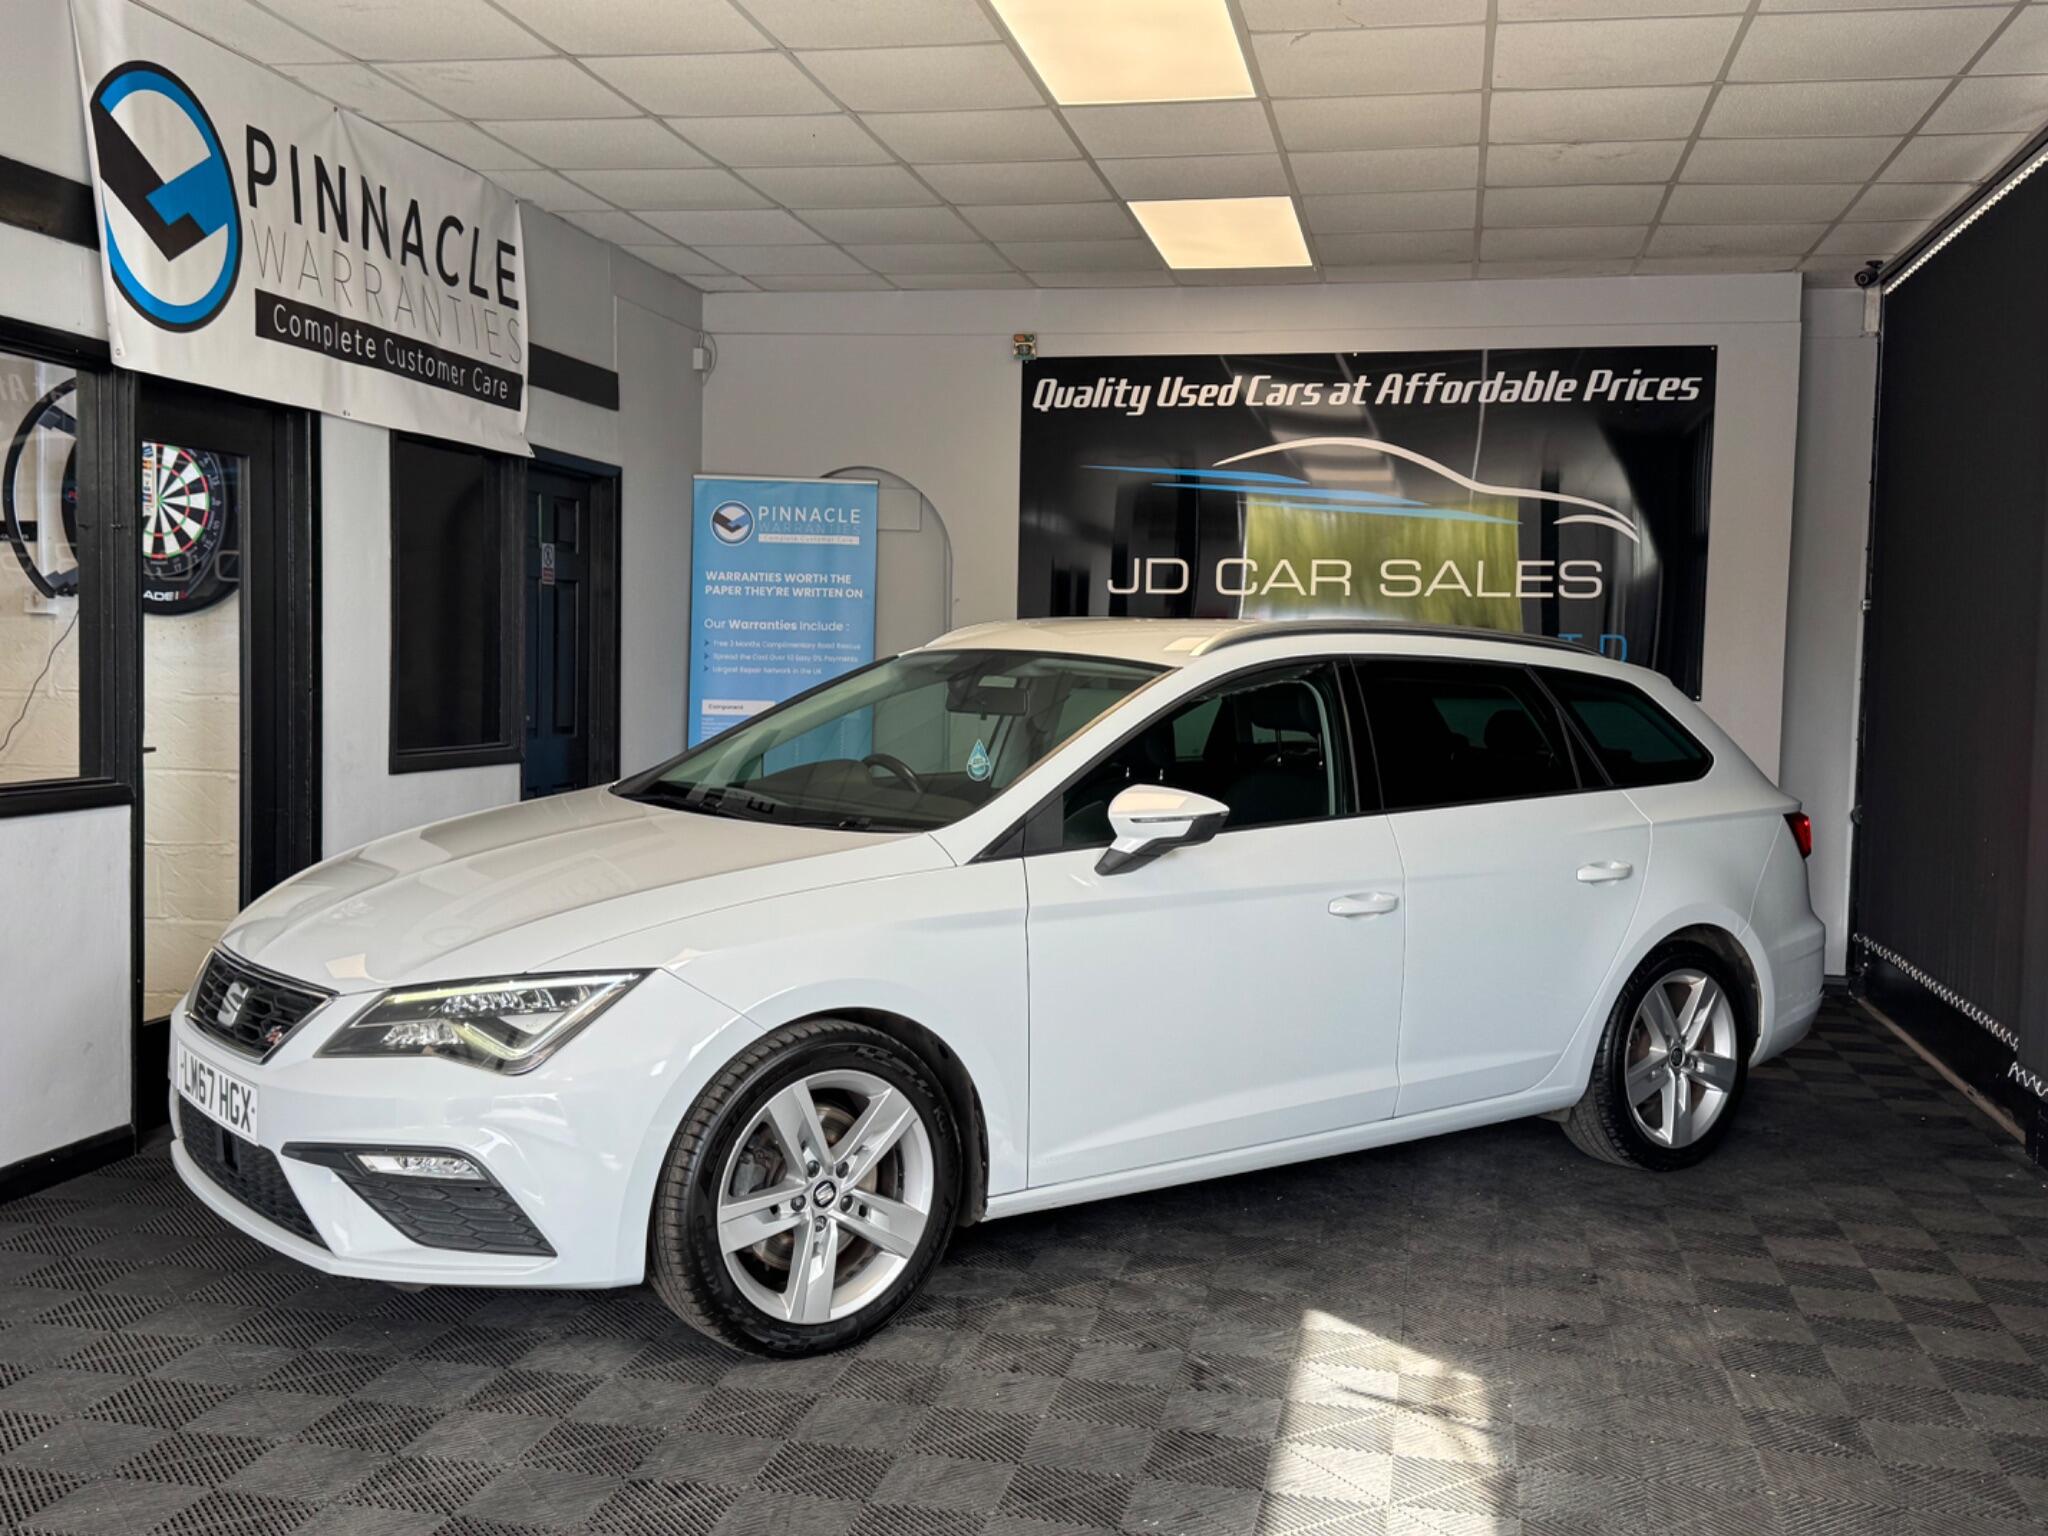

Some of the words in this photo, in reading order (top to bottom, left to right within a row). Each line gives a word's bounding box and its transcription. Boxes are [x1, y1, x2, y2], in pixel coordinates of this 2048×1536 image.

[246, 124, 519, 311] PINNACLE
[251, 218, 522, 364] WARRANTIES
[273, 303, 377, 360] Complete
[384, 337, 466, 387] Customer
[472, 367, 509, 400] Care
[1032, 377, 1152, 416] Quality
[1156, 375, 1242, 407] Used
[1245, 375, 1323, 406] Cars
[1328, 375, 1372, 405] at
[1374, 370, 1577, 405] Affordable
[1582, 368, 1702, 401] Prices
[758, 506, 861, 524] PINNACLE
[704, 584, 742, 595] PAPER
[744, 585, 790, 597] THEY'RE
[792, 587, 843, 598] WRITTEN
[845, 588, 864, 599] ON
[705, 571, 782, 583] WARRANTIES
[784, 573, 828, 584] WORTH
[831, 574, 852, 585] THE
[1106, 557, 1190, 595] JD
[1215, 557, 1352, 596] CAR
[1379, 558, 1604, 599] SALES
[704, 618, 725, 629] Our
[728, 618, 797, 631] Warranties
[184, 1051, 215, 1110] LM67
[219, 1074, 251, 1133] HGX
